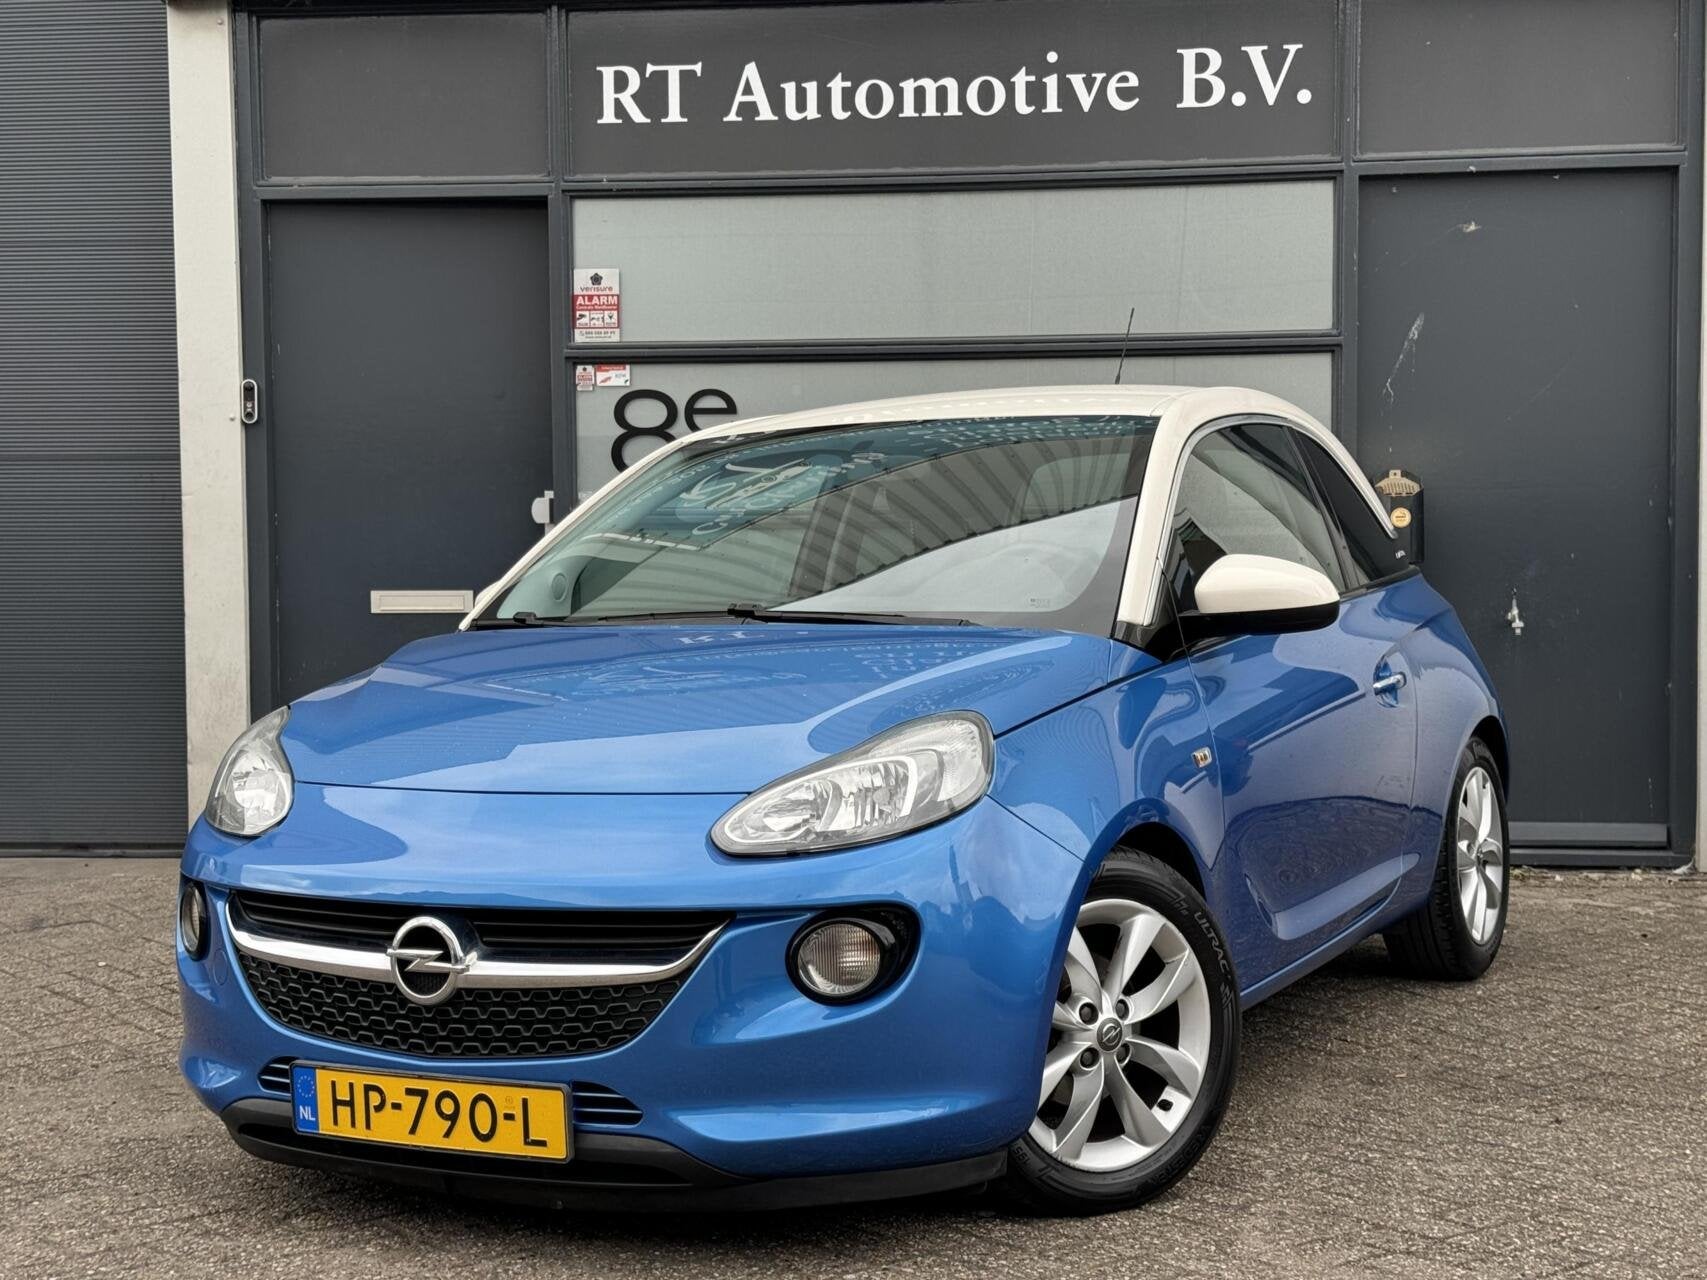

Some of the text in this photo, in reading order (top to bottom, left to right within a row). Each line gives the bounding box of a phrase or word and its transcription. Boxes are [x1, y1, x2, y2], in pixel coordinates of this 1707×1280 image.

[596, 44, 1312, 123] RT Automotive B.V.
[576, 295, 618, 305] ALARM
[299, 1104, 316, 1121] NL
[330, 1079, 548, 1148] HP-790-L
